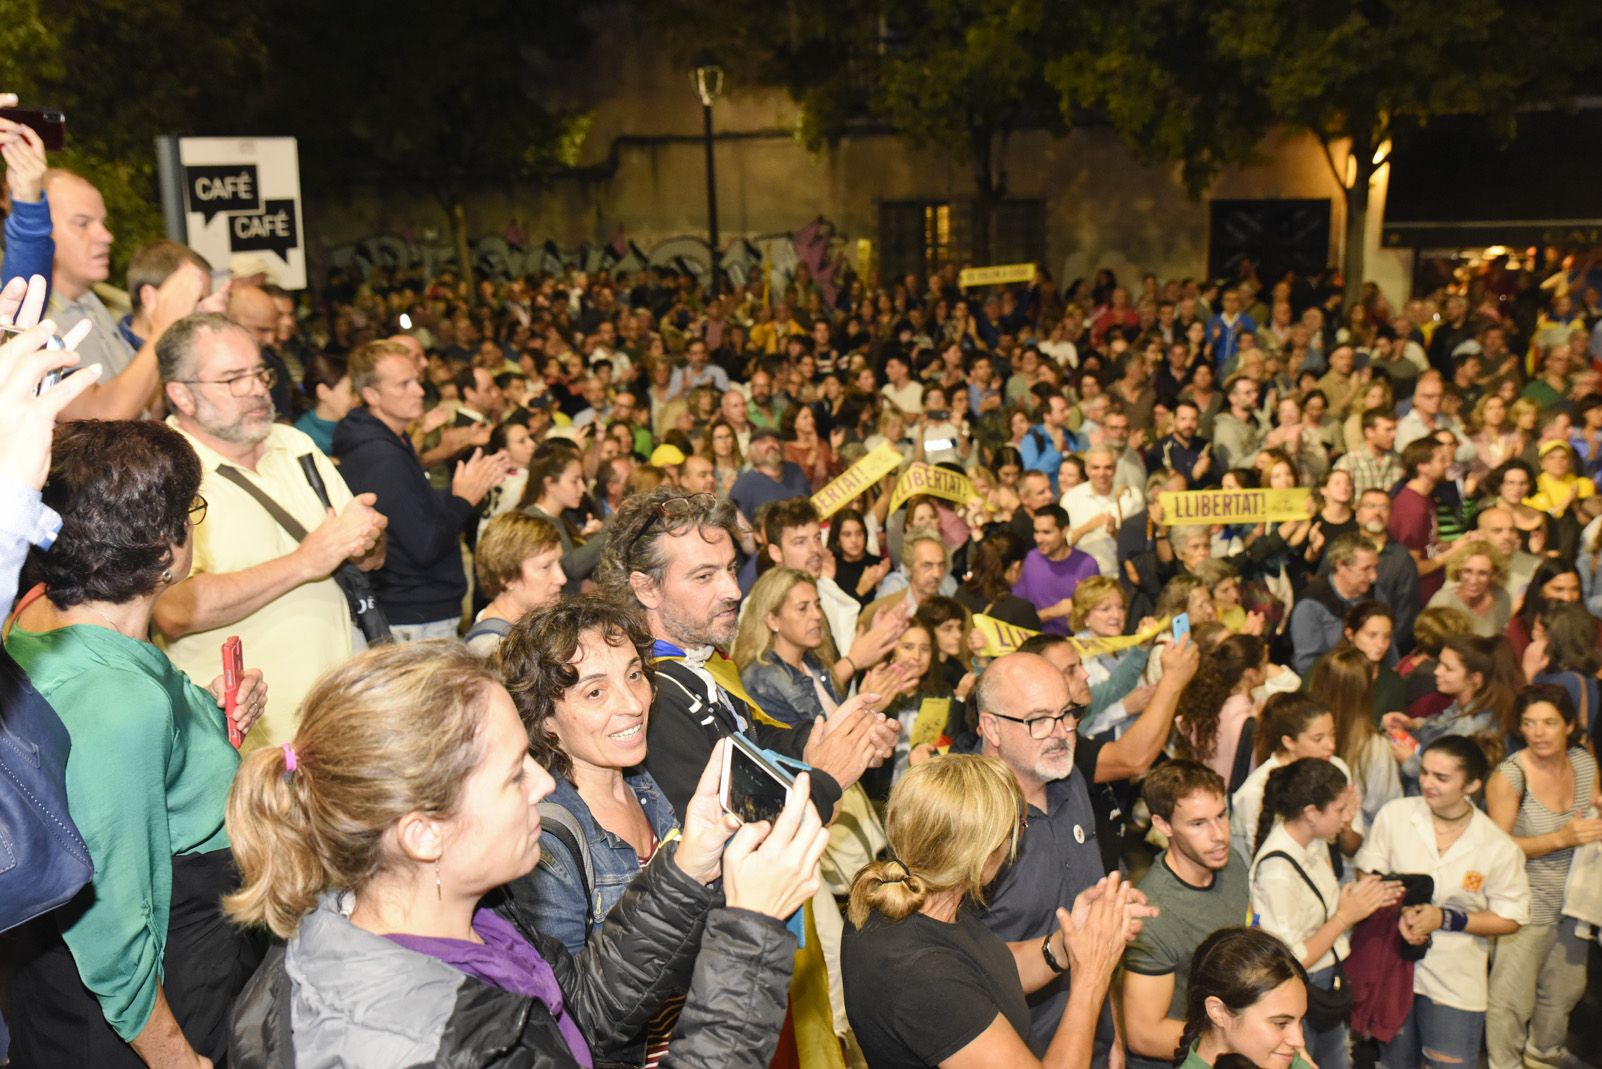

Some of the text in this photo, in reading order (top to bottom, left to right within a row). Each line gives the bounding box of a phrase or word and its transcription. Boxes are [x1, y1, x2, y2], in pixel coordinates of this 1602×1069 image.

[195, 171, 253, 201] CAFÉ
[234, 209, 290, 239] CAFÉ
[1175, 493, 1266, 518] LLIBERTAT!
